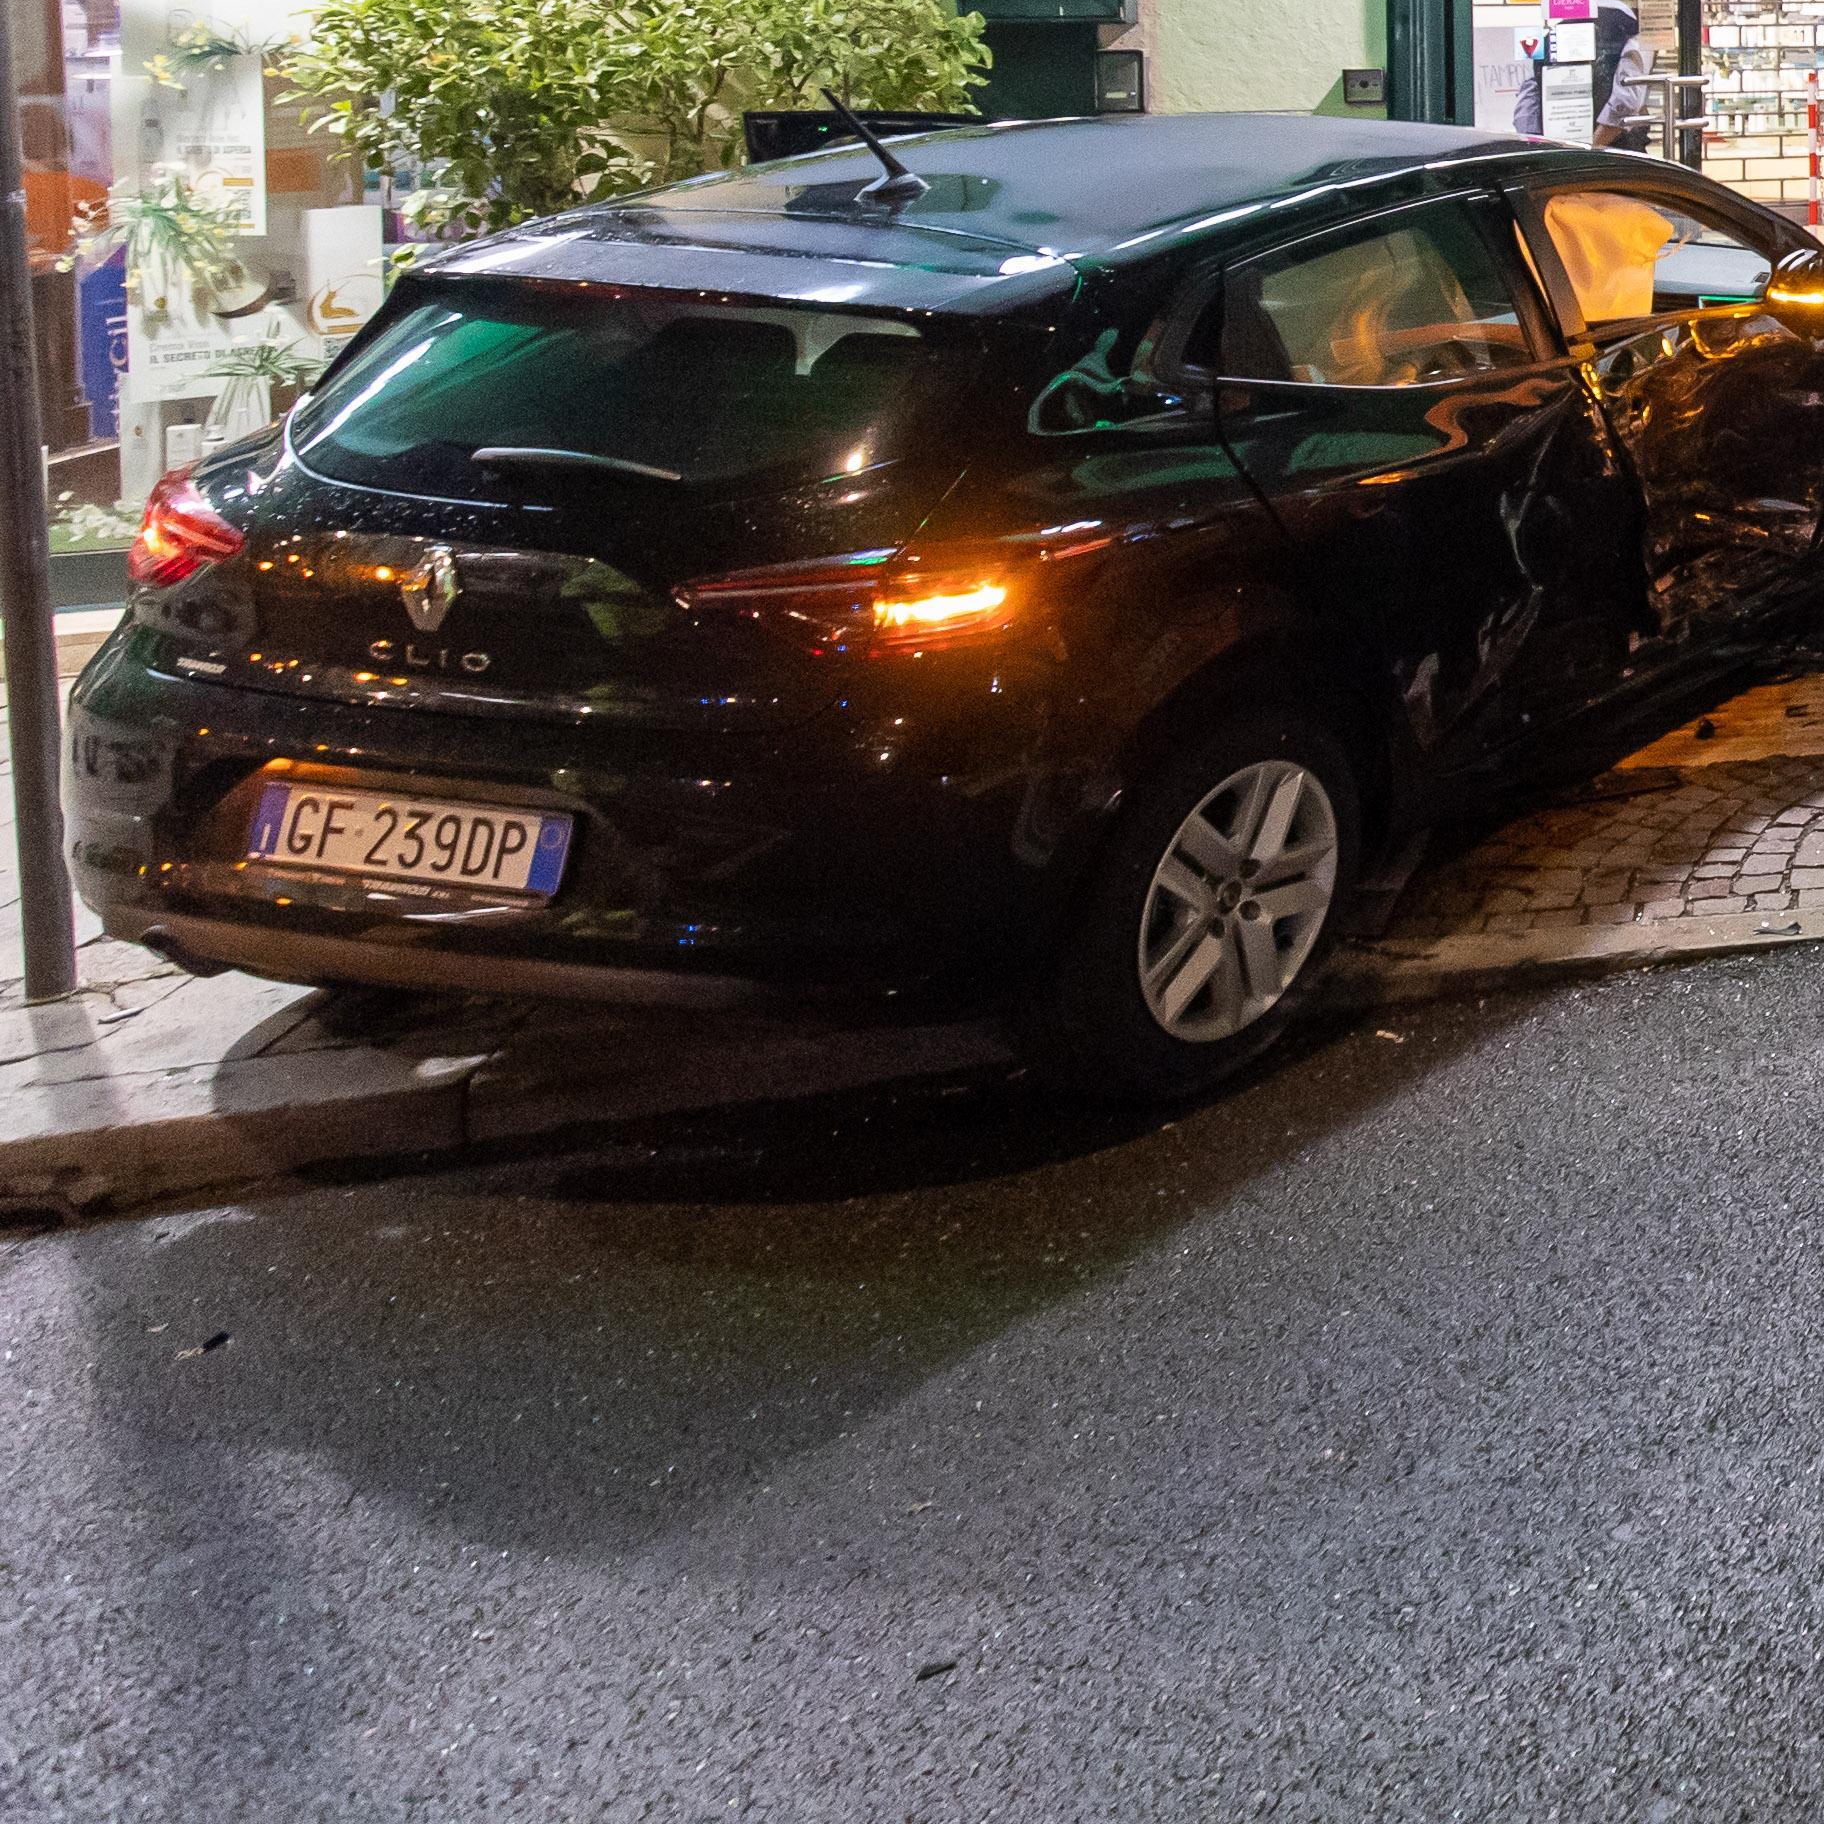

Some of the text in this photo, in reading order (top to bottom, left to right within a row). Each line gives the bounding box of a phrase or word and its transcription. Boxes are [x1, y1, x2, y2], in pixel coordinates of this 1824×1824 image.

[368, 639, 491, 673] CLIO
[286, 795, 355, 859] GF
[363, 804, 528, 880] 239DP
